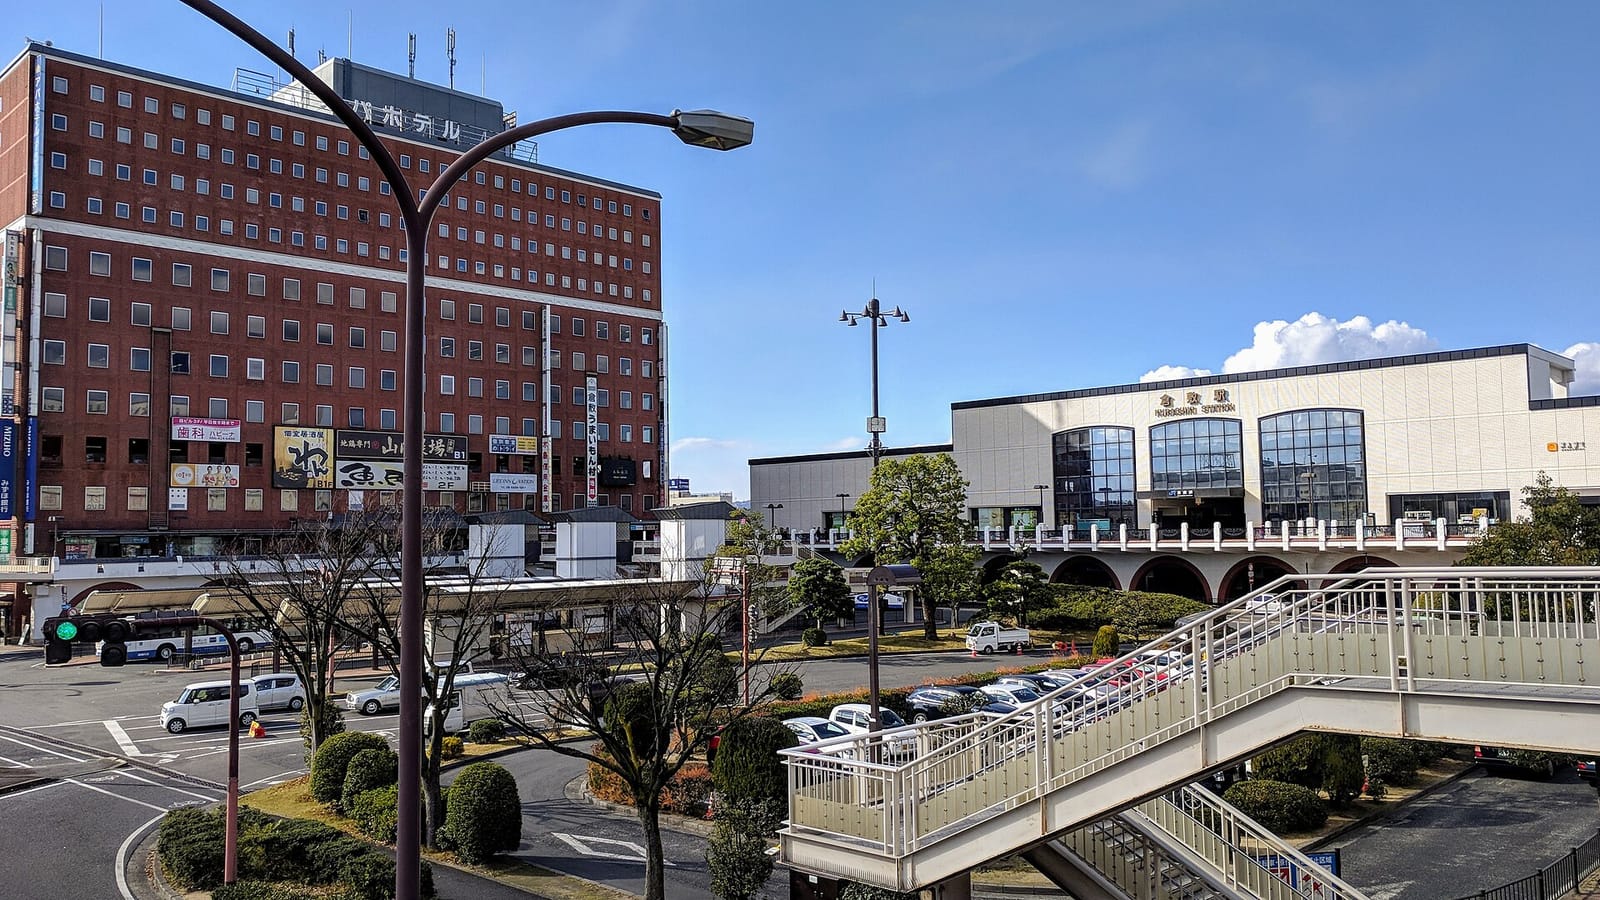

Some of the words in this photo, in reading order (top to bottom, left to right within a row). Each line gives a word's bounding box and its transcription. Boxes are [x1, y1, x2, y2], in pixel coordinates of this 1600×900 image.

[1160, 388, 1231, 408] 倉敷駅
[1155, 406, 1198, 418] KURASHIKI
[1201, 403, 1236, 414] STATION
[177, 426, 204, 440] 歯科
[588, 392, 597, 477] 倉敷うまいもん村
[454, 451, 465, 459] B1
[437, 481, 455, 489] 2F
